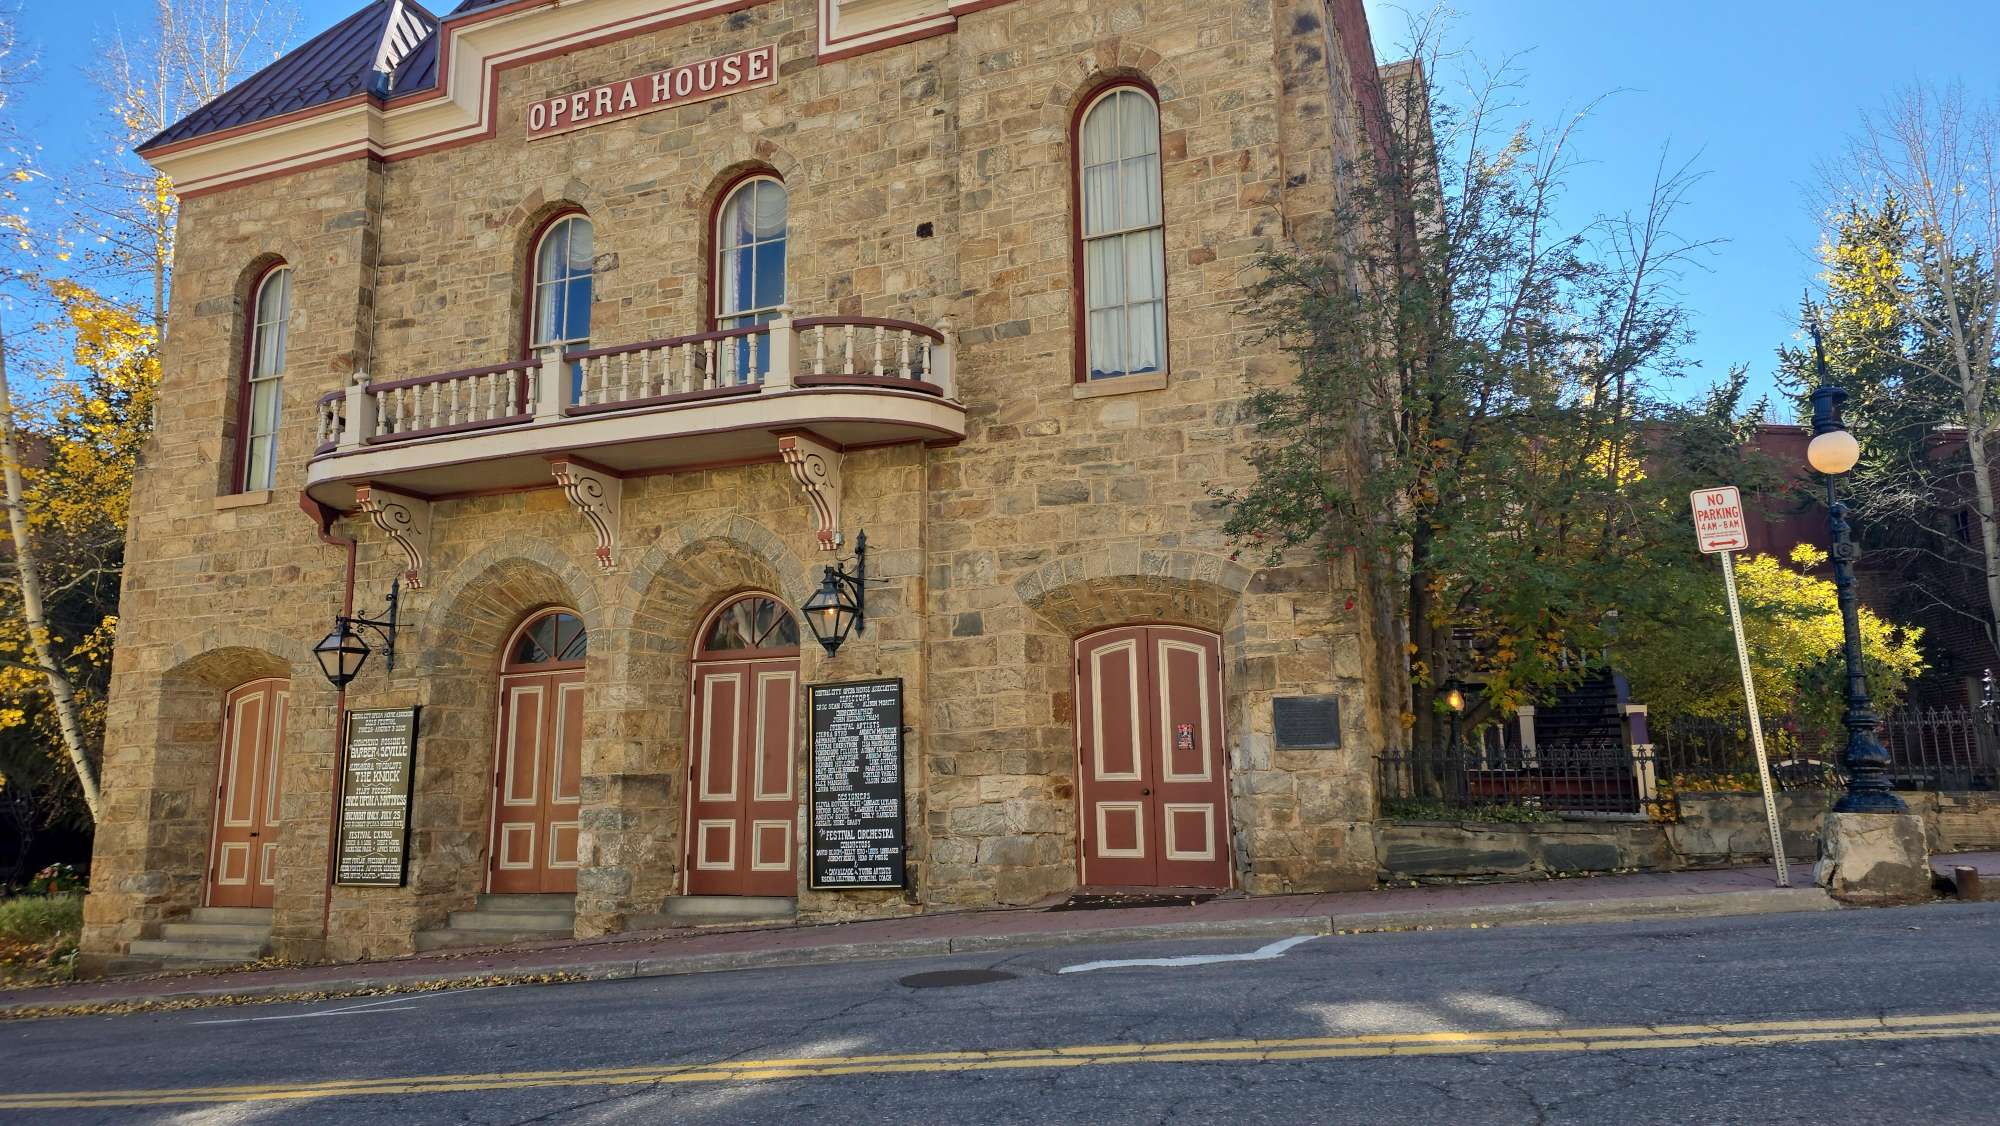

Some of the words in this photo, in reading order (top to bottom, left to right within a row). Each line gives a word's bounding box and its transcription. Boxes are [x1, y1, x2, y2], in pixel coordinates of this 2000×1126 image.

[529, 81, 638, 131] OPERA
[651, 49, 769, 103] HOUSE
[1706, 494, 1724, 506] NO
[1697, 506, 1739, 522] PARKING
[351, 747, 376, 758] BARBER
[380, 746, 408, 757] SEVILLE
[355, 771, 371, 782] THE
[373, 770, 400, 782] KNOCK
[345, 795, 358, 806] ONCE
[360, 795, 374, 806] UPON
[349, 831, 372, 839] FESTIVAL
[826, 830, 855, 840] FESTIVAL
[858, 828, 894, 839] ORCHESTRA
